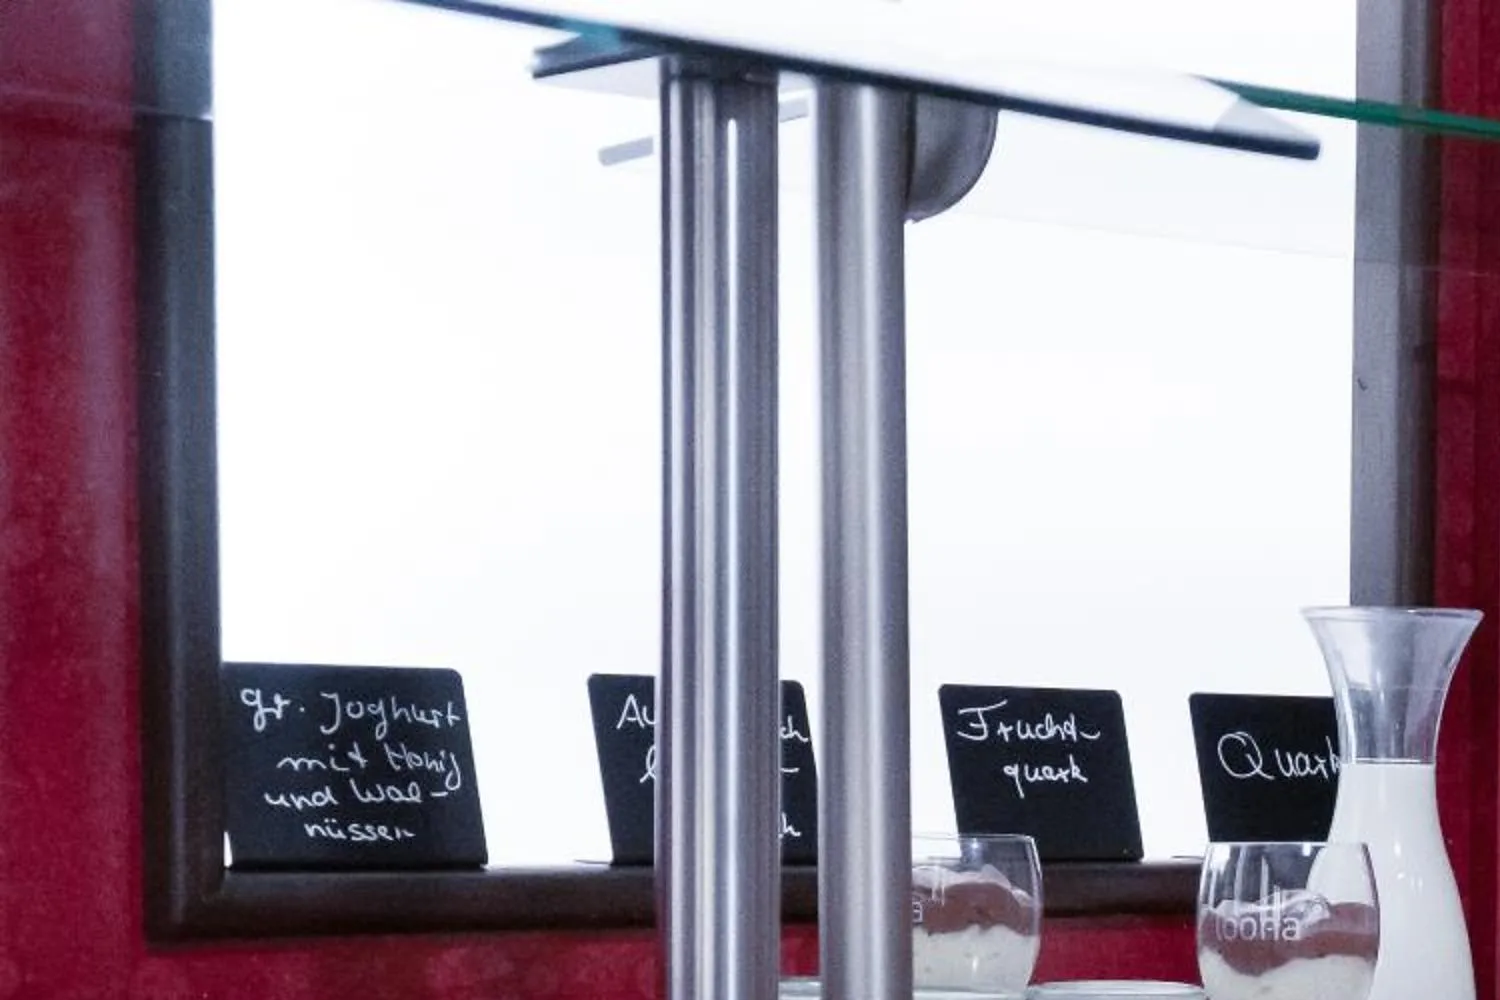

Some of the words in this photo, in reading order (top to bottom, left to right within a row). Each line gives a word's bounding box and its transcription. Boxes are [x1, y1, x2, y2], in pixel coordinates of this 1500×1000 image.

[319, 691, 462, 741] Joghurt
[275, 742, 368, 773] mit
[383, 742, 462, 791] Honig
[1003, 753, 1089, 800] quark
[263, 785, 339, 810] und
[303, 818, 416, 842] nüssen
